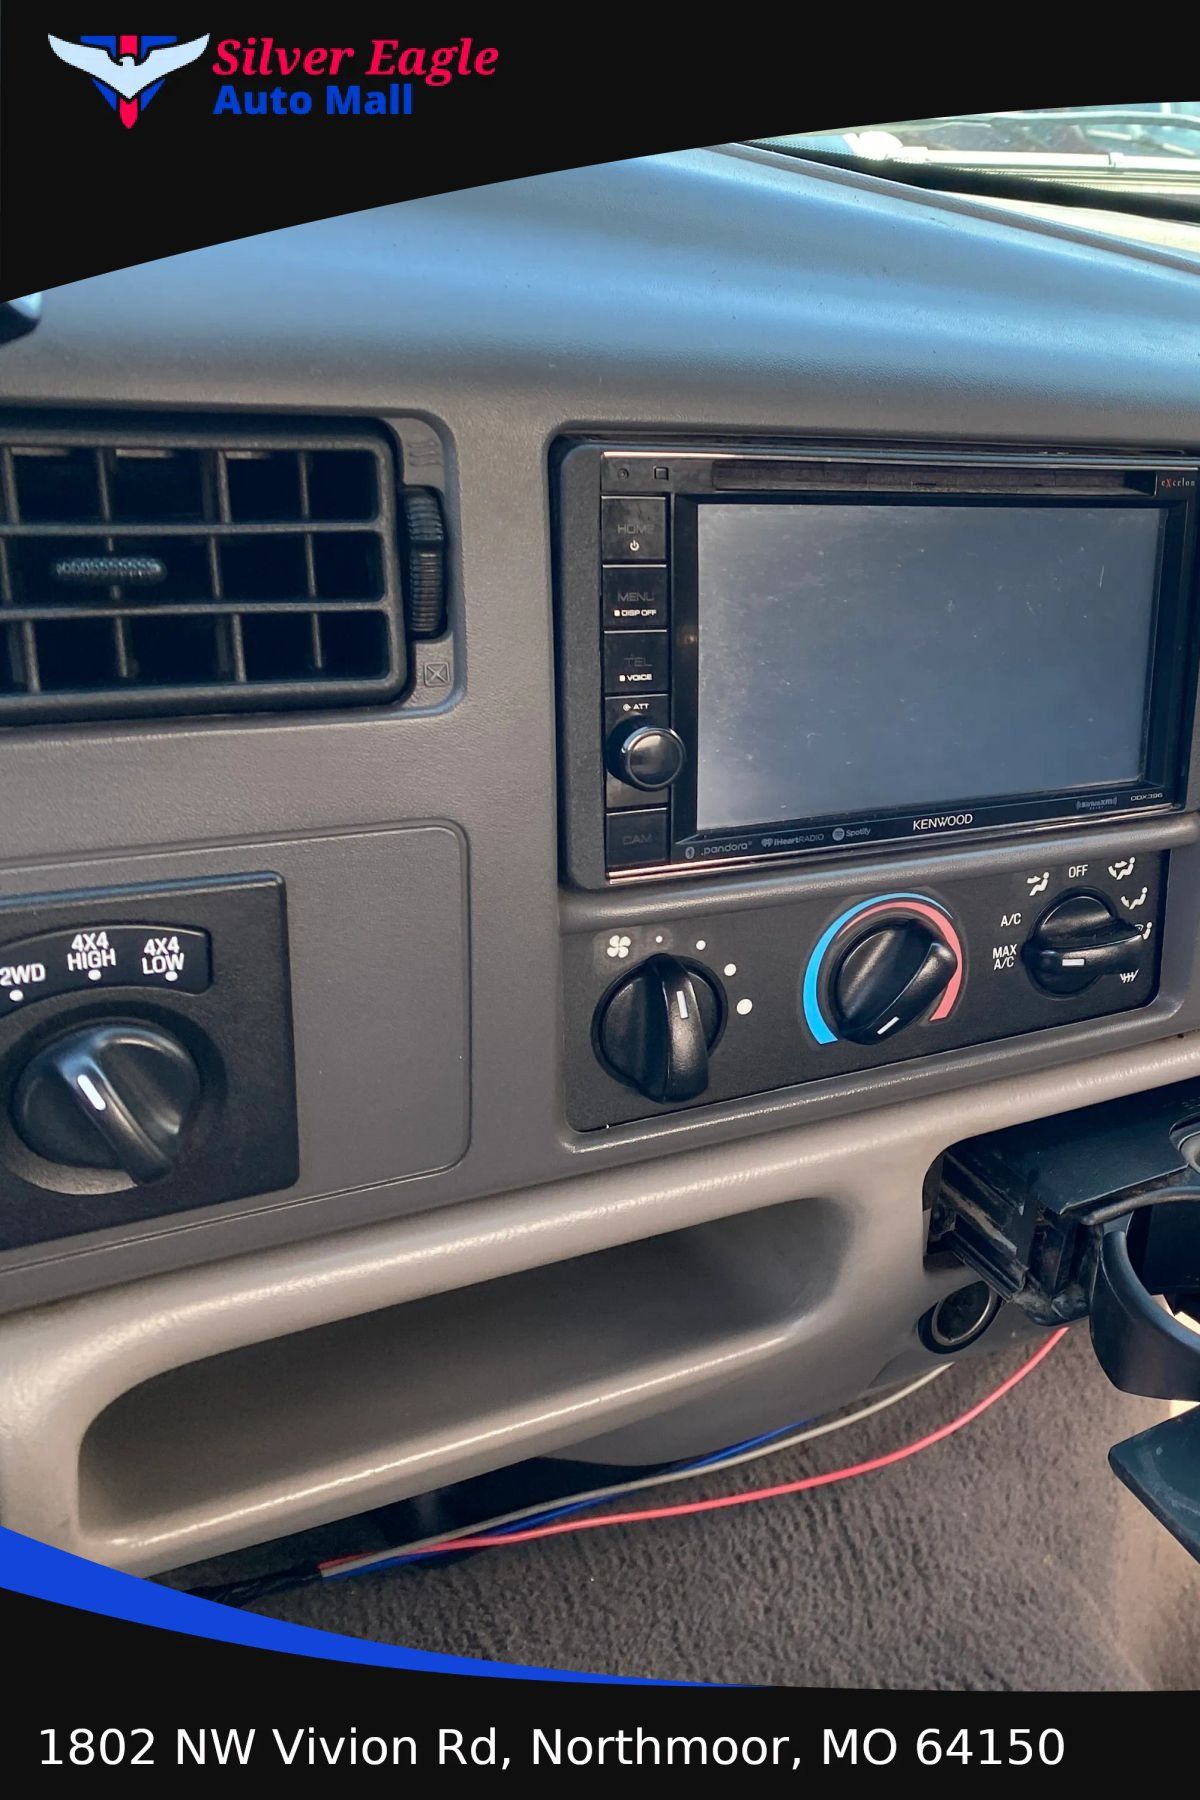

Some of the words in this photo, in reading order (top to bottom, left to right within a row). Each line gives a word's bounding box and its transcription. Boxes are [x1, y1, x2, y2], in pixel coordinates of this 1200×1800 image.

[617, 592, 656, 602] MENU
[621, 609, 640, 617] DISP
[912, 813, 974, 831] KENWOOD
[846, 827, 871, 837] Spotify
[1068, 864, 1089, 879] OFF
[1000, 912, 1022, 927] A/C
[71, 931, 109, 952] 4X4
[143, 936, 180, 955] 4X4
[992, 944, 1018, 959] MAX
[67, 948, 117, 971] HIGH
[142, 953, 185, 975] LOW
[993, 957, 1015, 970] A/C
[0, 963, 46, 986] 2WD
